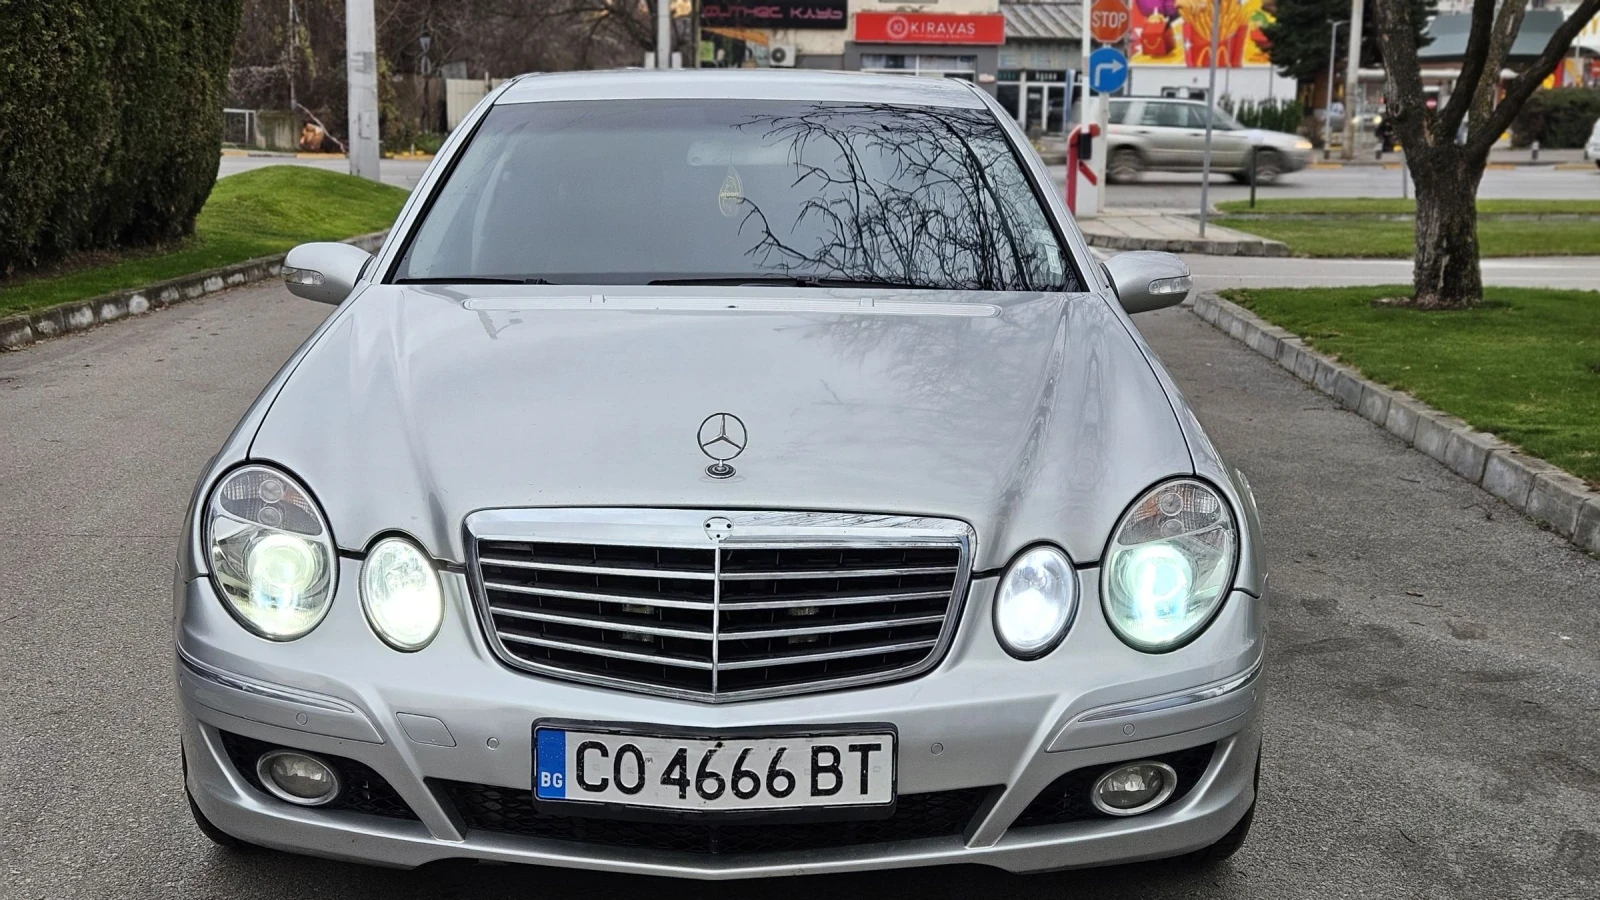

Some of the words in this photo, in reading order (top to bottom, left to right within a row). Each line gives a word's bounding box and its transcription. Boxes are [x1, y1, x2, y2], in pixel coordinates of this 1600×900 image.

[1092, 11, 1128, 28] STOP
[910, 22, 976, 35] KIRAVAS
[540, 771, 563, 788] BG
[660, 746, 796, 801] 4666
[810, 743, 883, 798] BT
